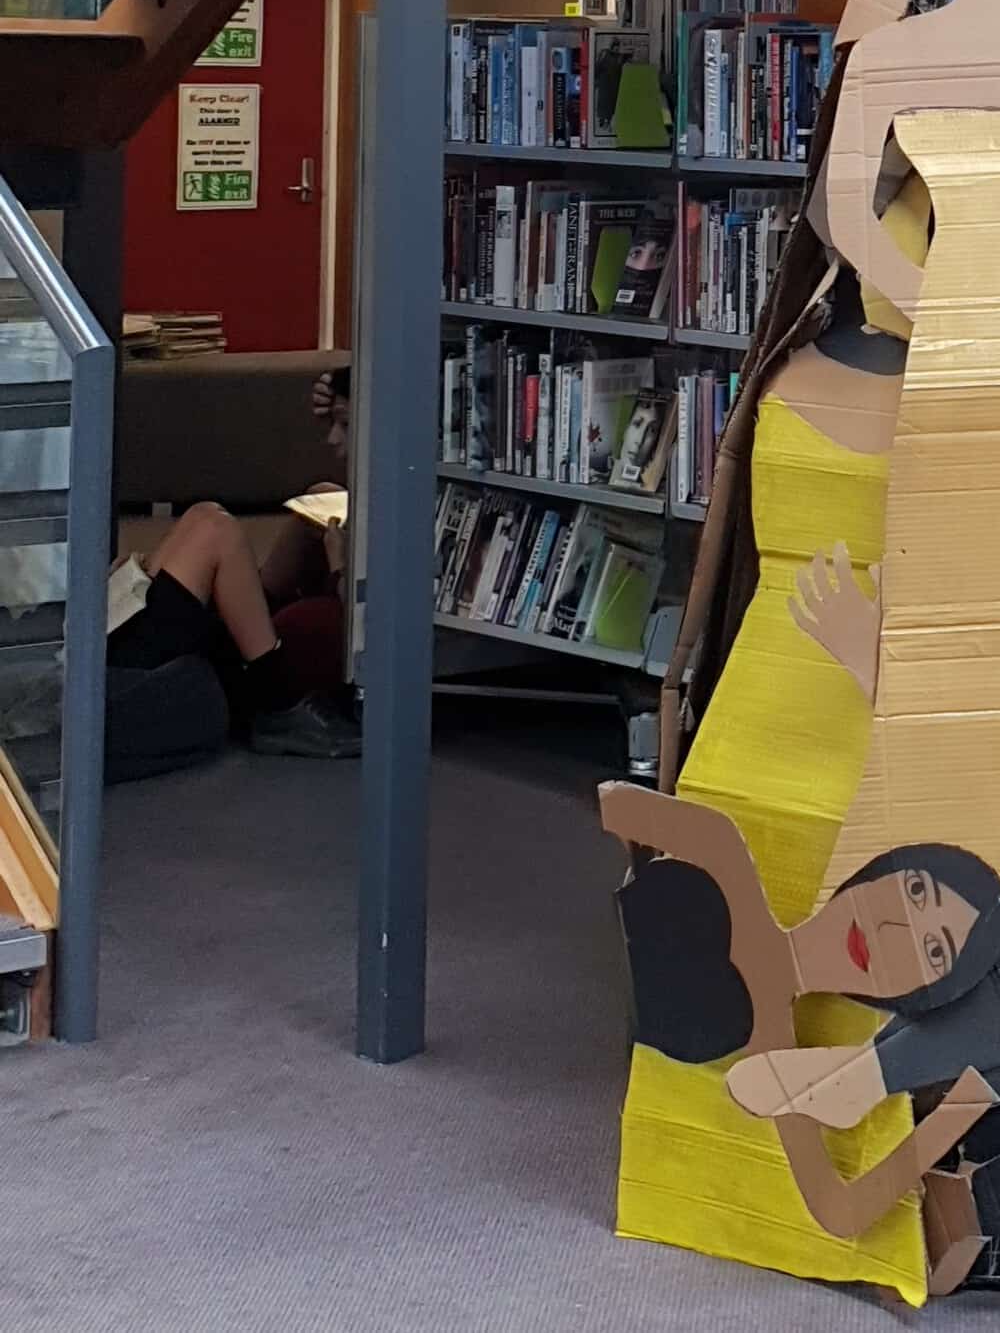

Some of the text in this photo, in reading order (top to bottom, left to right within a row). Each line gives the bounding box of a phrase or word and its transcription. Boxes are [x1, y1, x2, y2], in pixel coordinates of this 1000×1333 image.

[230, 31, 254, 42] Fire
[229, 45, 252, 57] exit
[225, 174, 248, 184] Fire
[225, 188, 247, 199] exit
